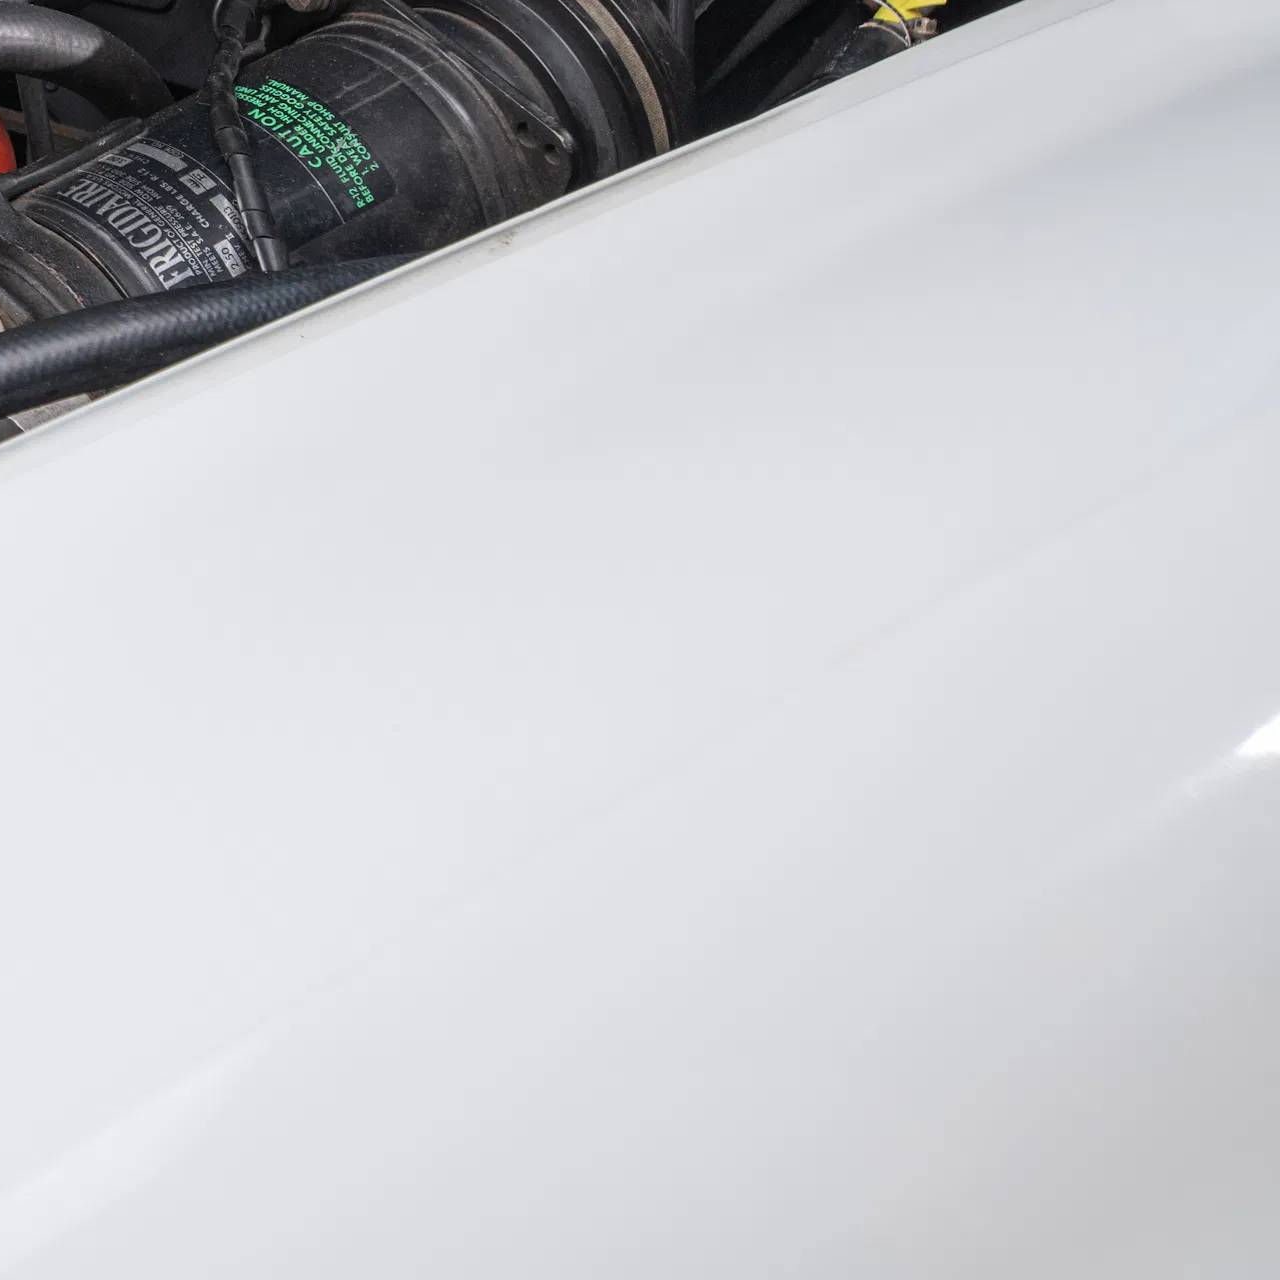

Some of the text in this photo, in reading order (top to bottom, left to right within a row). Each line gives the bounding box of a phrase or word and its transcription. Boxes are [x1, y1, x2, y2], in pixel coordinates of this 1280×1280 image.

[256, 93, 279, 103] ANY
[259, 85, 304, 109] GOGGLES
[267, 107, 294, 125] HIGH
[268, 79, 379, 171] 2. CONSULT SHOP MANUAL
[303, 109, 337, 136] SAFETY
[248, 108, 322, 168] CAUTION
[294, 125, 325, 153] UNDER
[137, 166, 158, 181] R-12
[325, 156, 350, 183] FLUID
[361, 167, 369, 175] 1.
[345, 164, 375, 203] BEFORE
[175, 193, 210, 229] CHARGE
[348, 187, 366, 208] R-12
[134, 198, 165, 227] GENERAL
[57, 178, 196, 291] FRIGIDAIRE
[164, 226, 175, 238] OF
[173, 238, 202, 275] PRODUCT
[187, 238, 203, 256] TEST
[203, 246, 223, 273] MEETS
